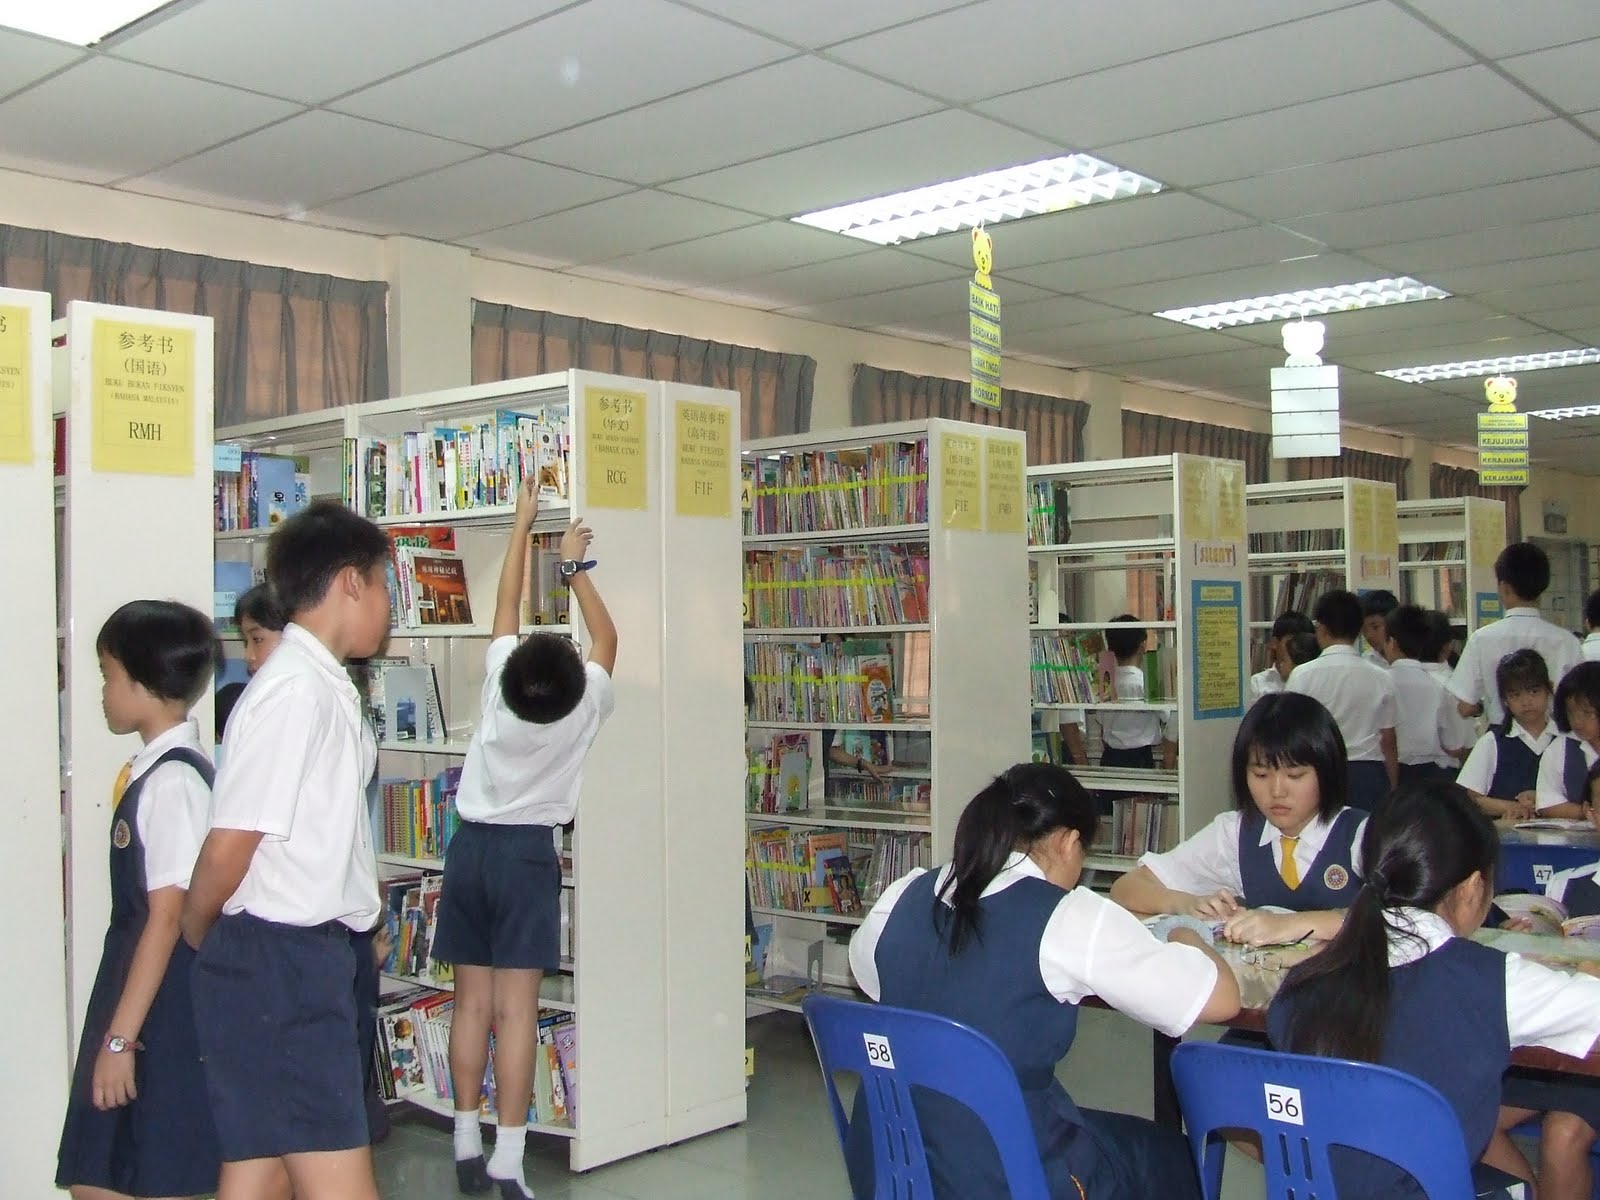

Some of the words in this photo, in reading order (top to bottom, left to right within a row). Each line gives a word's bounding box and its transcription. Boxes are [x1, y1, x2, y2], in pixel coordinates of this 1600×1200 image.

[119, 331, 173, 354] 参考书
[124, 358, 167, 376] (国语)
[154, 382, 184, 392] FIKSYEN
[973, 386, 997, 403] HORMAT
[599, 396, 633, 414] 参考书
[129, 421, 161, 441] RMH
[607, 469, 627, 485] RCG
[694, 480, 713, 496] FIF
[532, 533, 540, 545] A
[535, 615, 541, 626] B
[559, 614, 567, 625] C
[1536, 870, 1552, 881] 47
[804, 890, 811, 903] X
[437, 961, 449, 975] N
[867, 1041, 891, 1062] 58
[1269, 1093, 1298, 1117] 56
